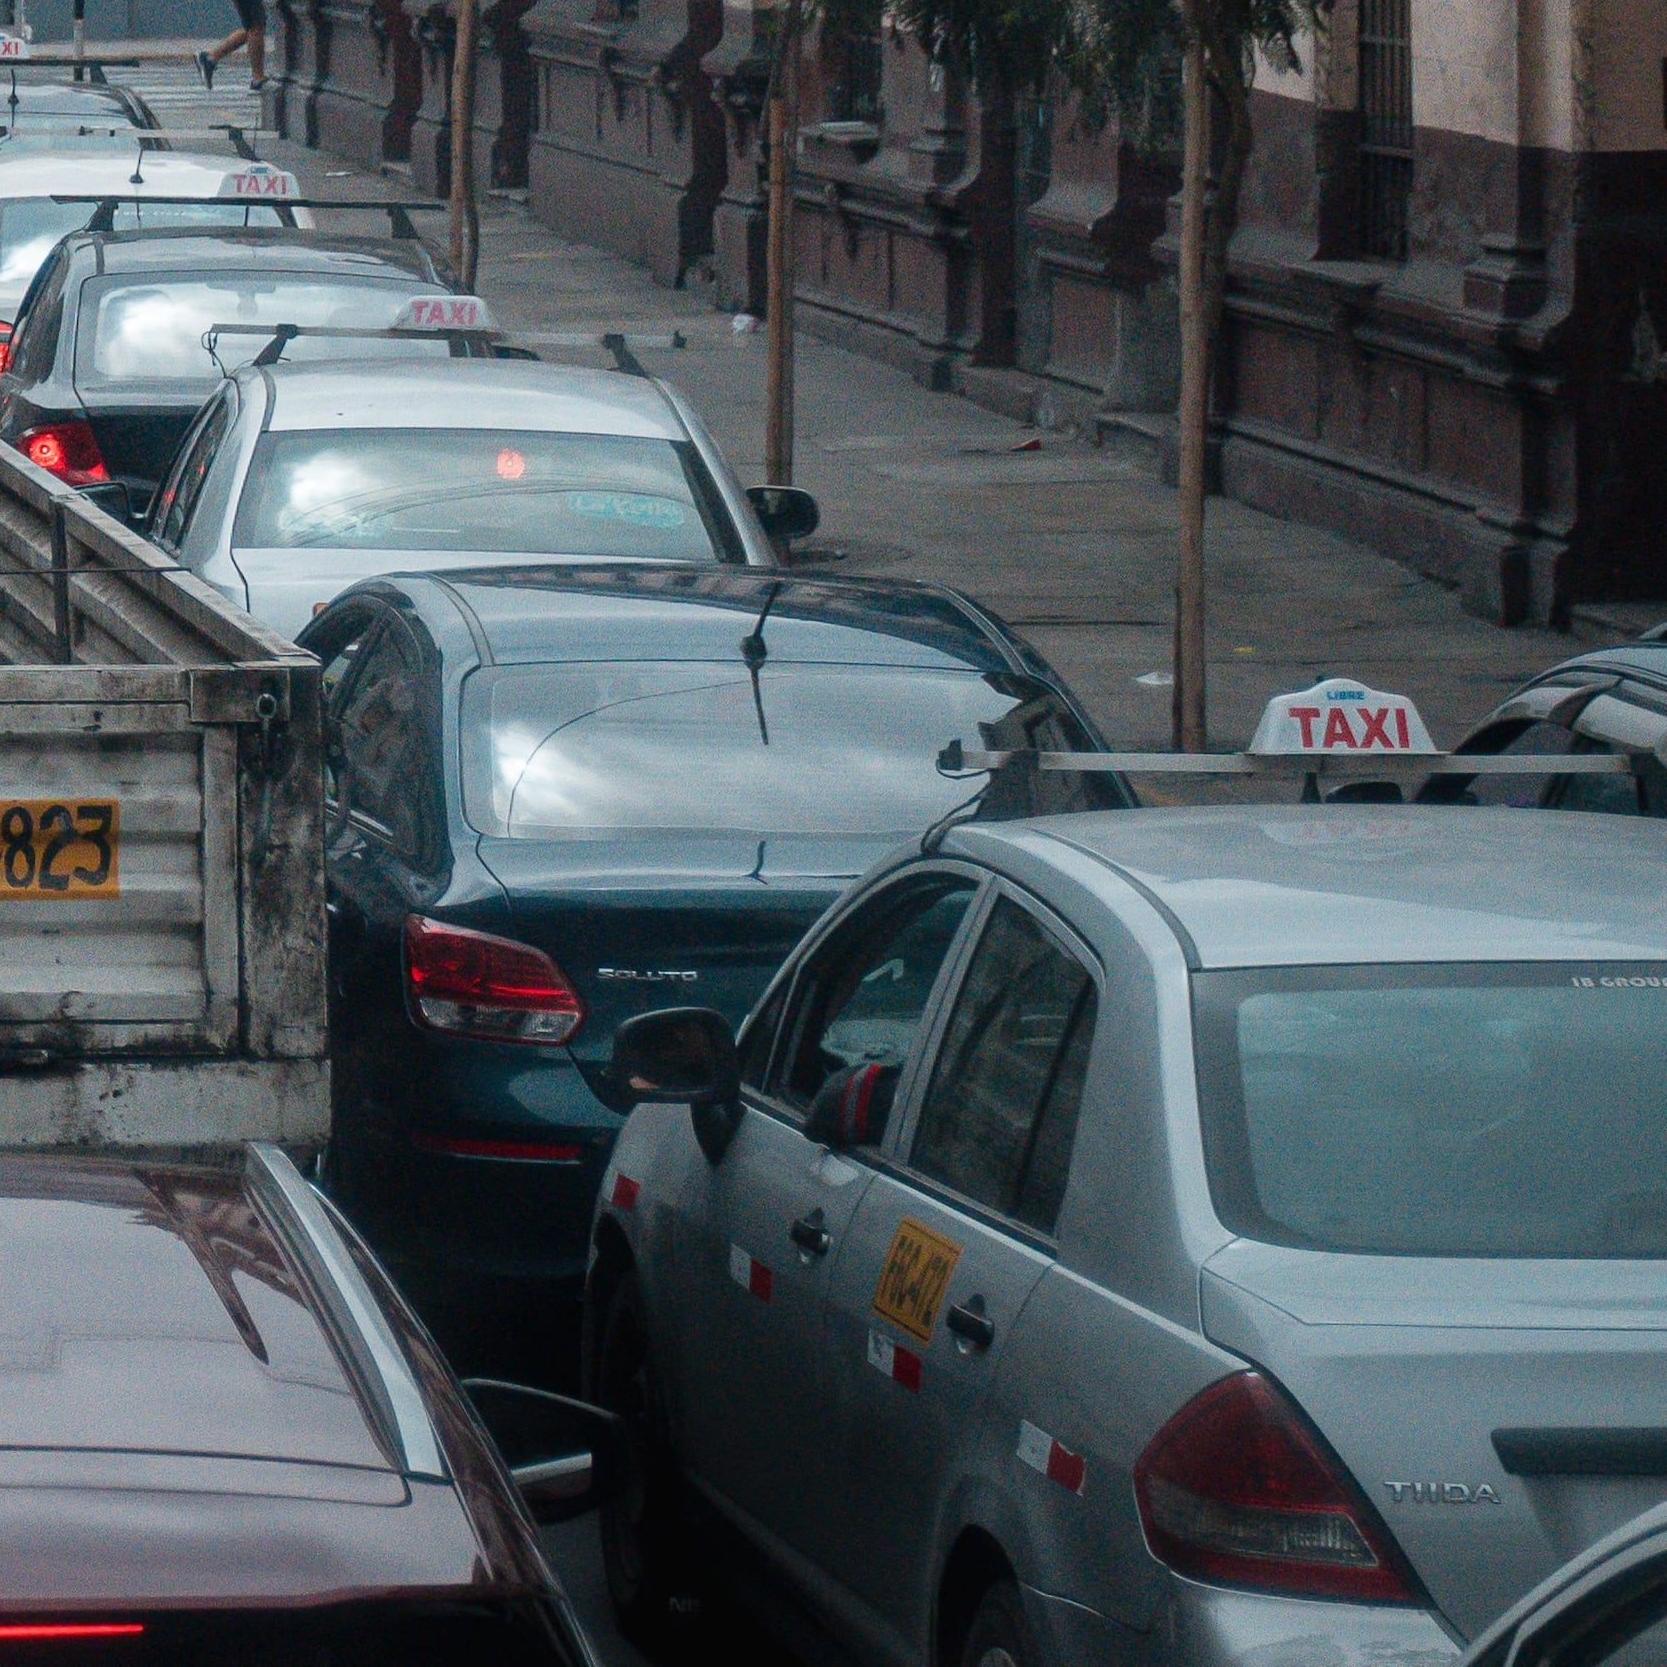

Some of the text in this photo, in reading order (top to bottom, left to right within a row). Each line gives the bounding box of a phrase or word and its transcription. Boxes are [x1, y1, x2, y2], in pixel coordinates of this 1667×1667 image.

[234, 174, 287, 195] TAXI
[411, 300, 477, 326] TAXI
[1326, 690, 1365, 701] LIBRE
[1288, 707, 1411, 749] TAXI
[595, 967, 699, 982] SOLUTO
[1384, 1481, 1503, 1504] TIIDA
